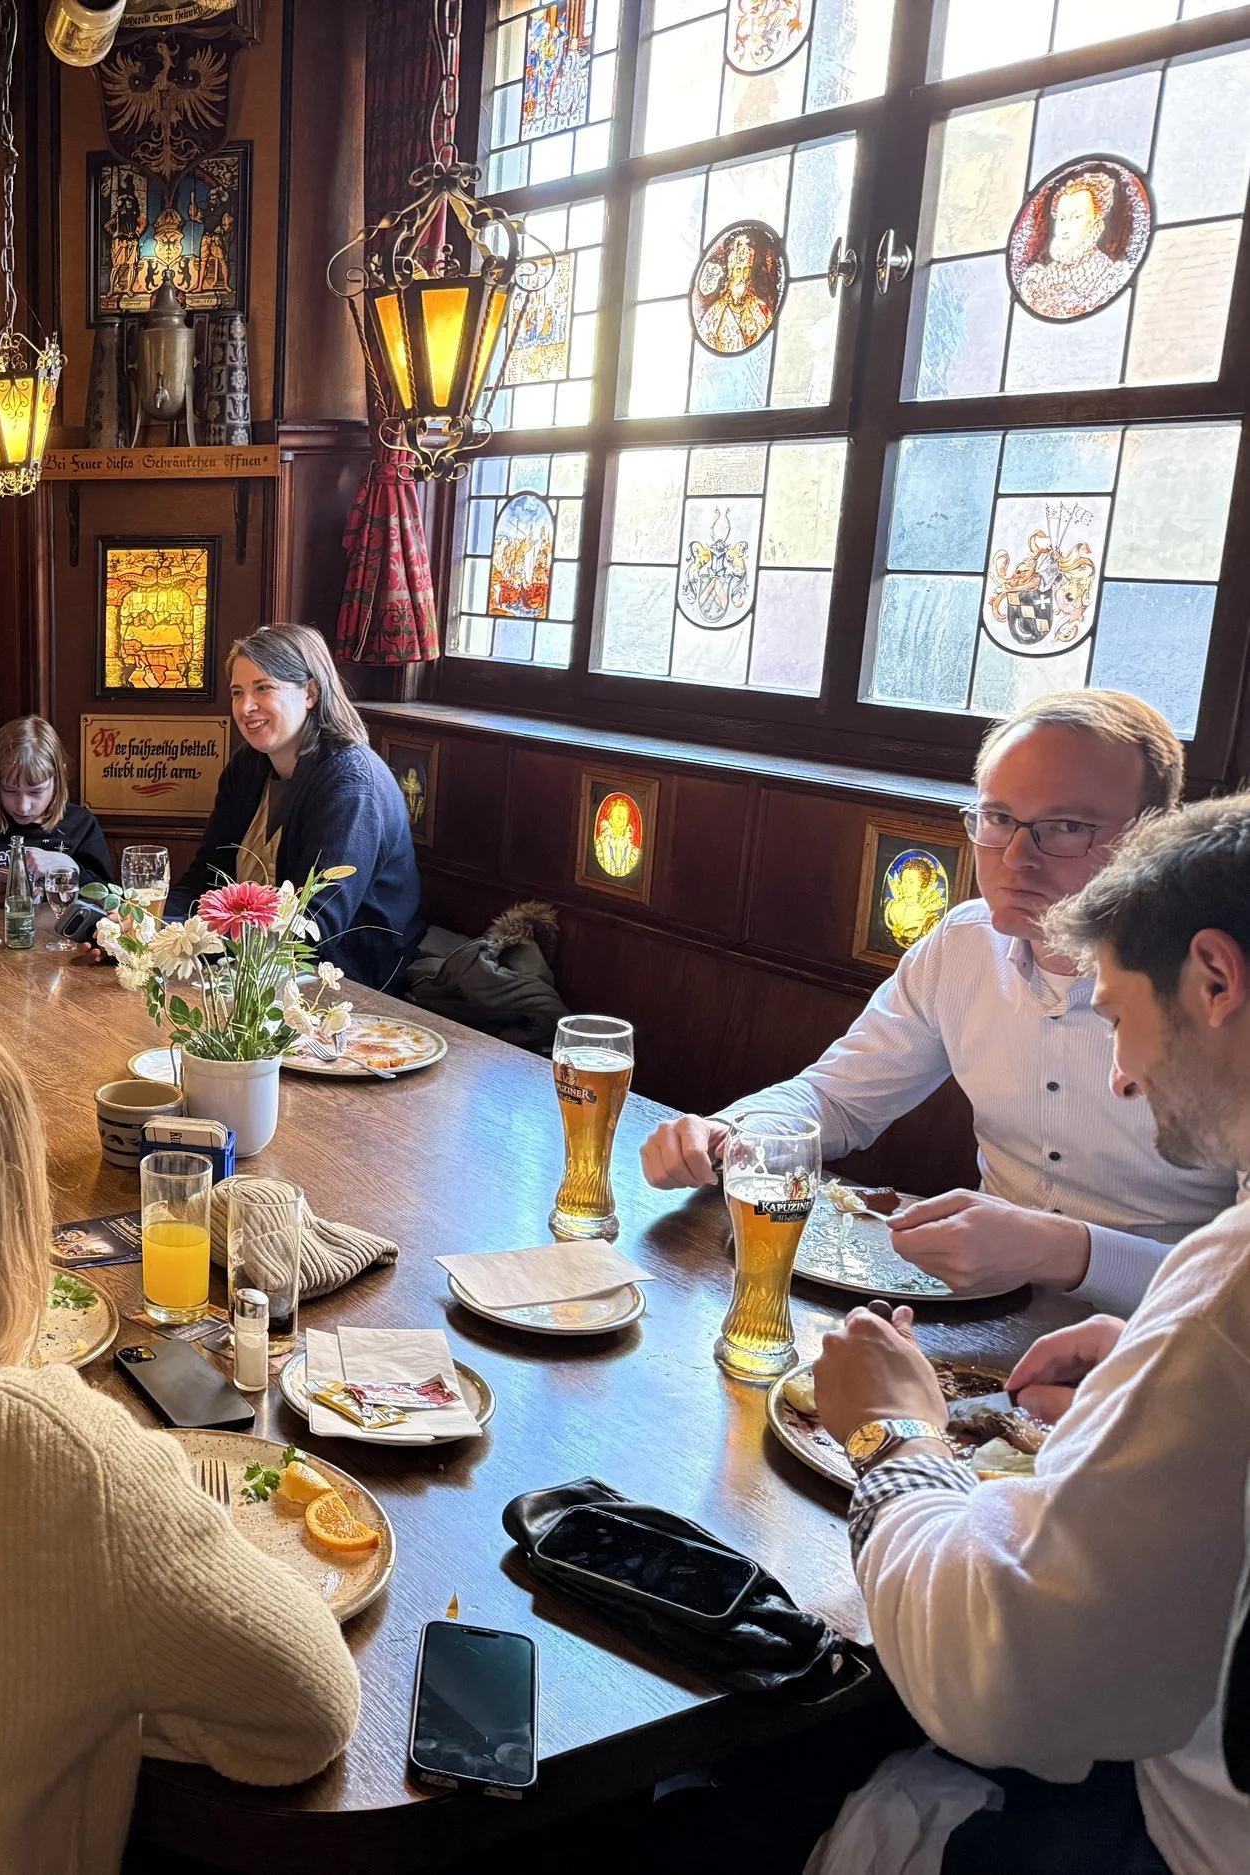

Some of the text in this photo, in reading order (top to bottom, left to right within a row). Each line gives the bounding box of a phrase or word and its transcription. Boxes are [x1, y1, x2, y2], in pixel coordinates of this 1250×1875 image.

[152, 13, 173, 23] Georg
[44, 452, 66, 471] Bei
[70, 454, 102, 473] Feuer
[91, 727, 126, 758] Wer
[125, 737, 179, 762] frühzeitig
[102, 760, 202, 783] stirbt nicht arm
[169, 1131, 182, 1145] KU
